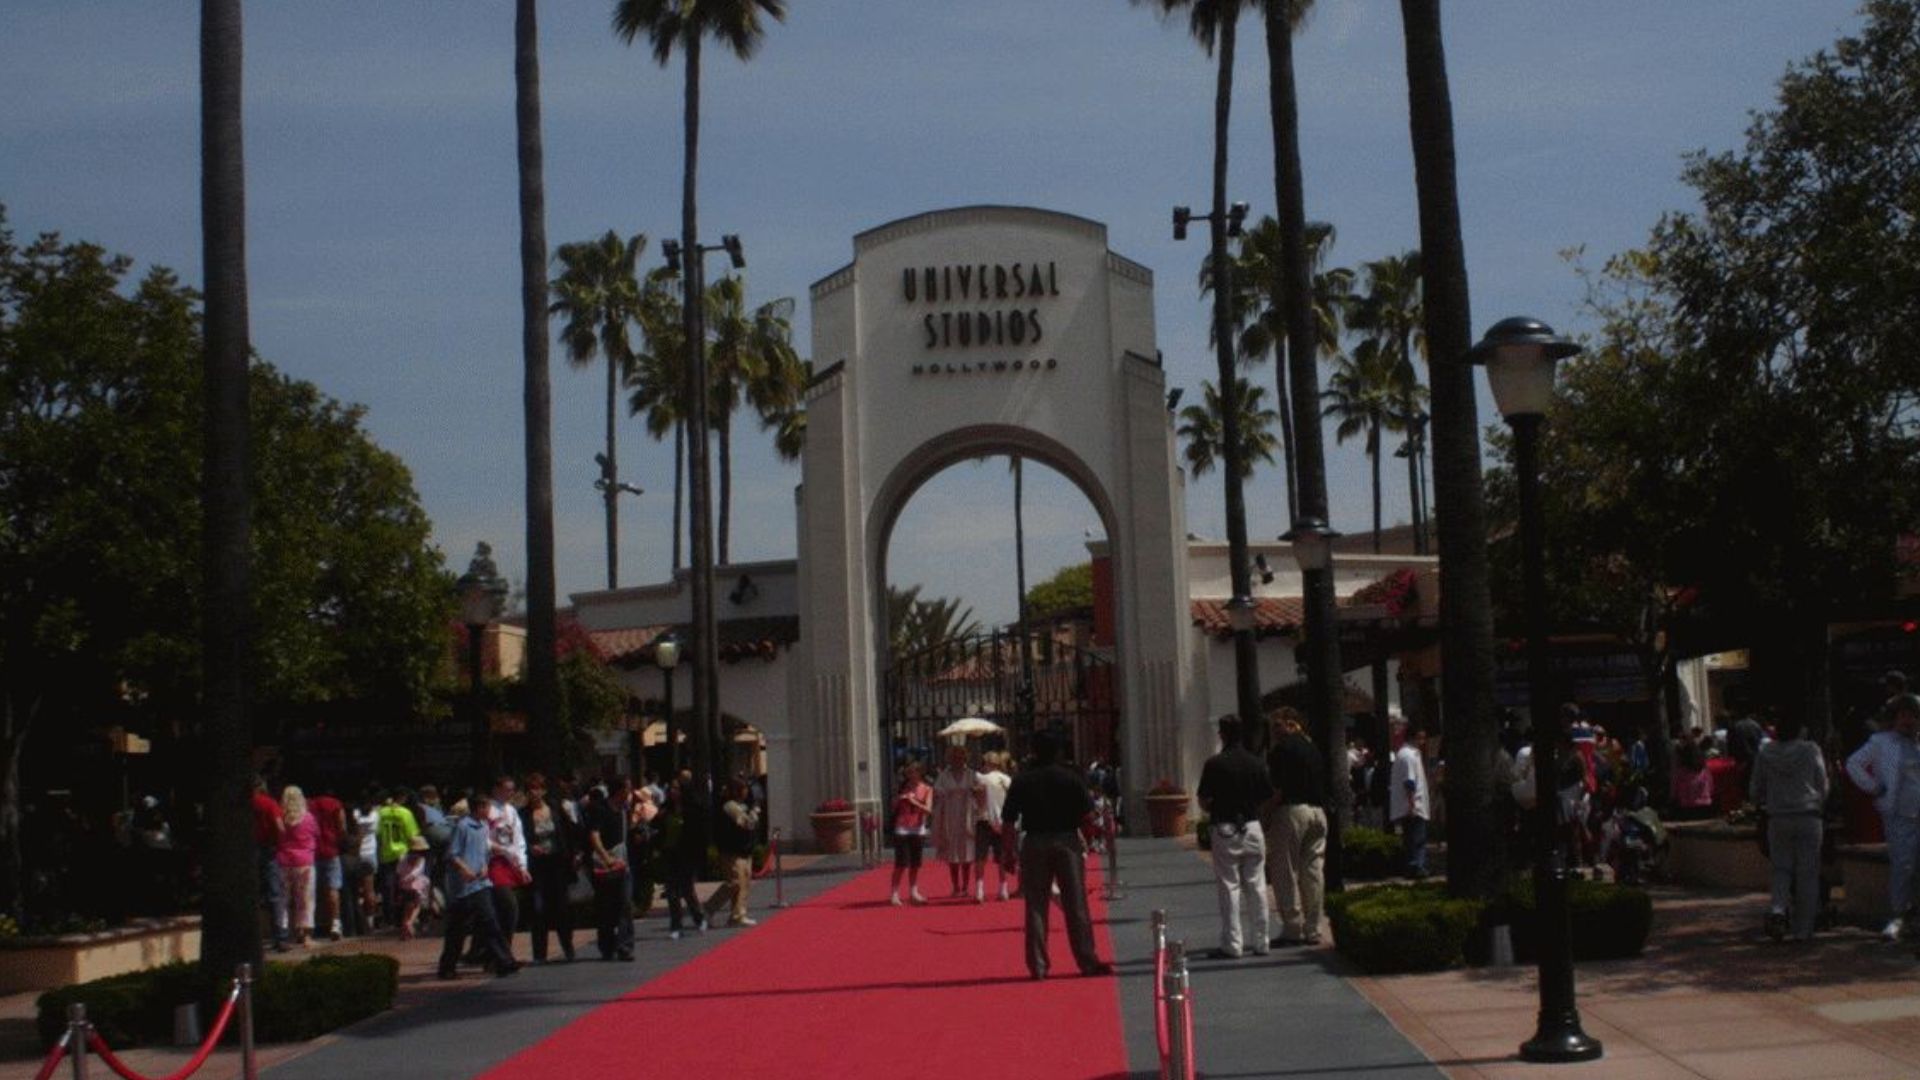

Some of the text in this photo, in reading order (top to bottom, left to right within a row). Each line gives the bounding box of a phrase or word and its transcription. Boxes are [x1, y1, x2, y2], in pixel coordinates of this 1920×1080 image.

[903, 261, 1060, 302] UNIVERSAL
[923, 309, 1042, 349] STUDIOS
[912, 358, 1058, 375] HOLLYWOOD
